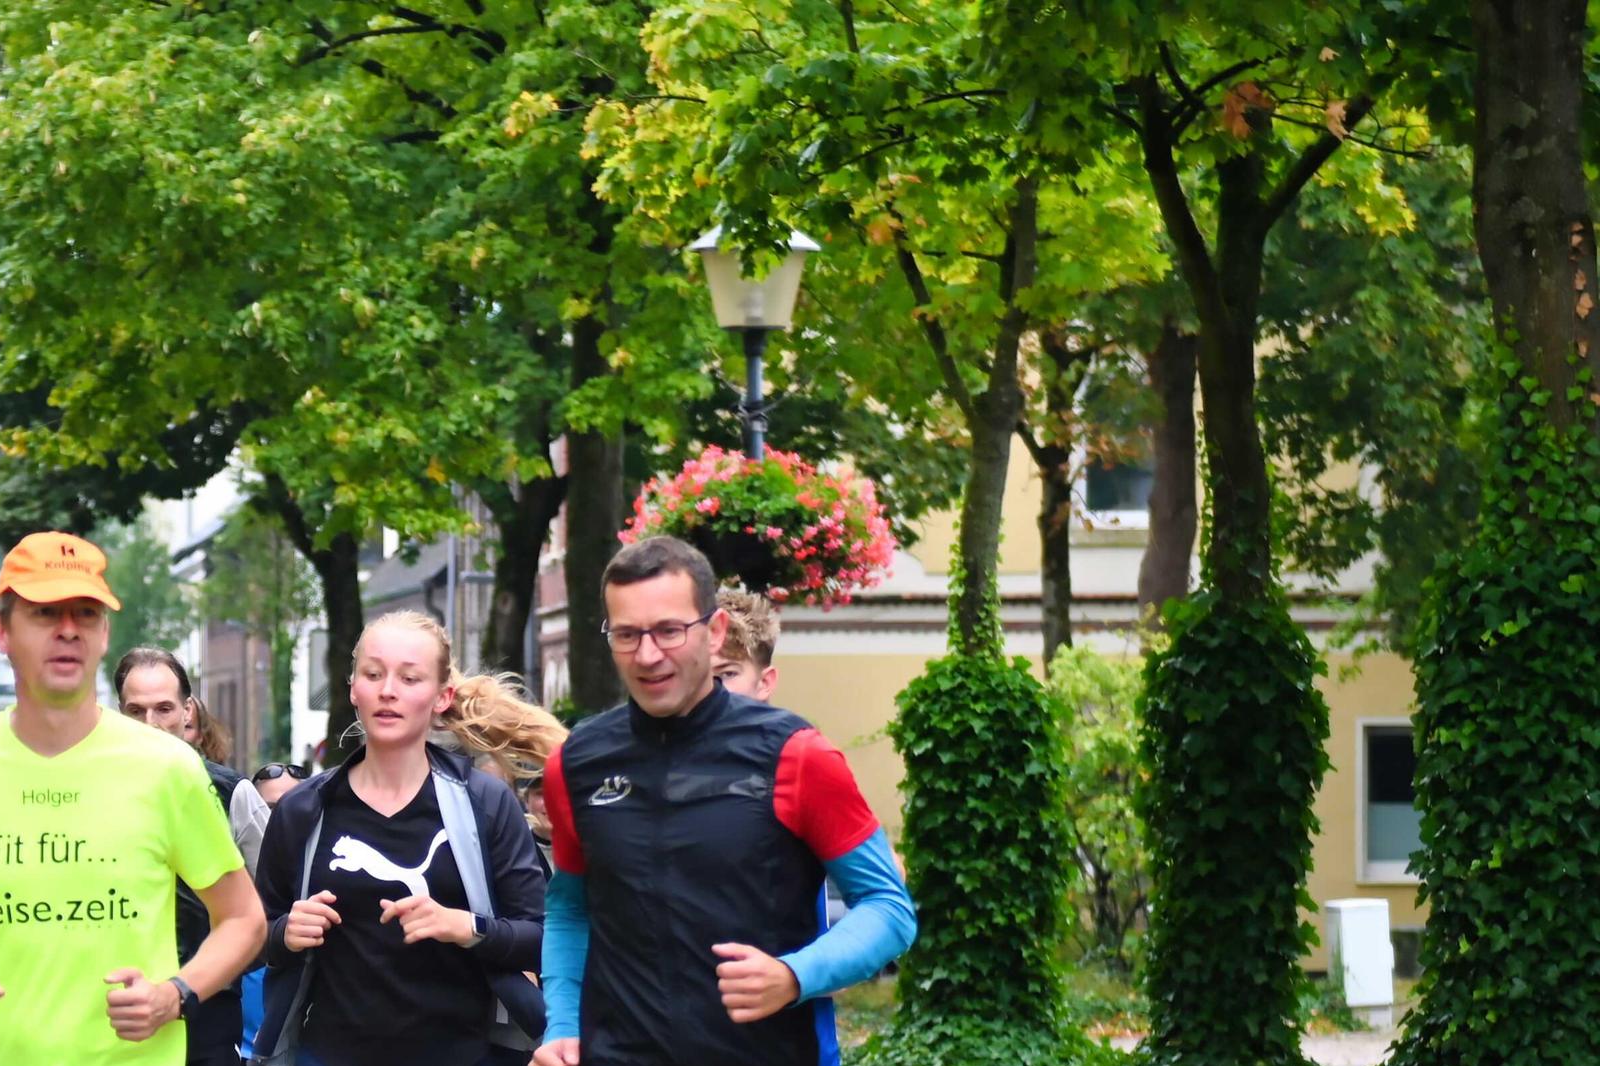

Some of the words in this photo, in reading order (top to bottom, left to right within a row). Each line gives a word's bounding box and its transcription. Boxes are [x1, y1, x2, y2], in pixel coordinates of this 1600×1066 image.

[45, 561, 92, 575] Kolping
[22, 789, 80, 807] Holger
[37, 832, 117, 863] für...
